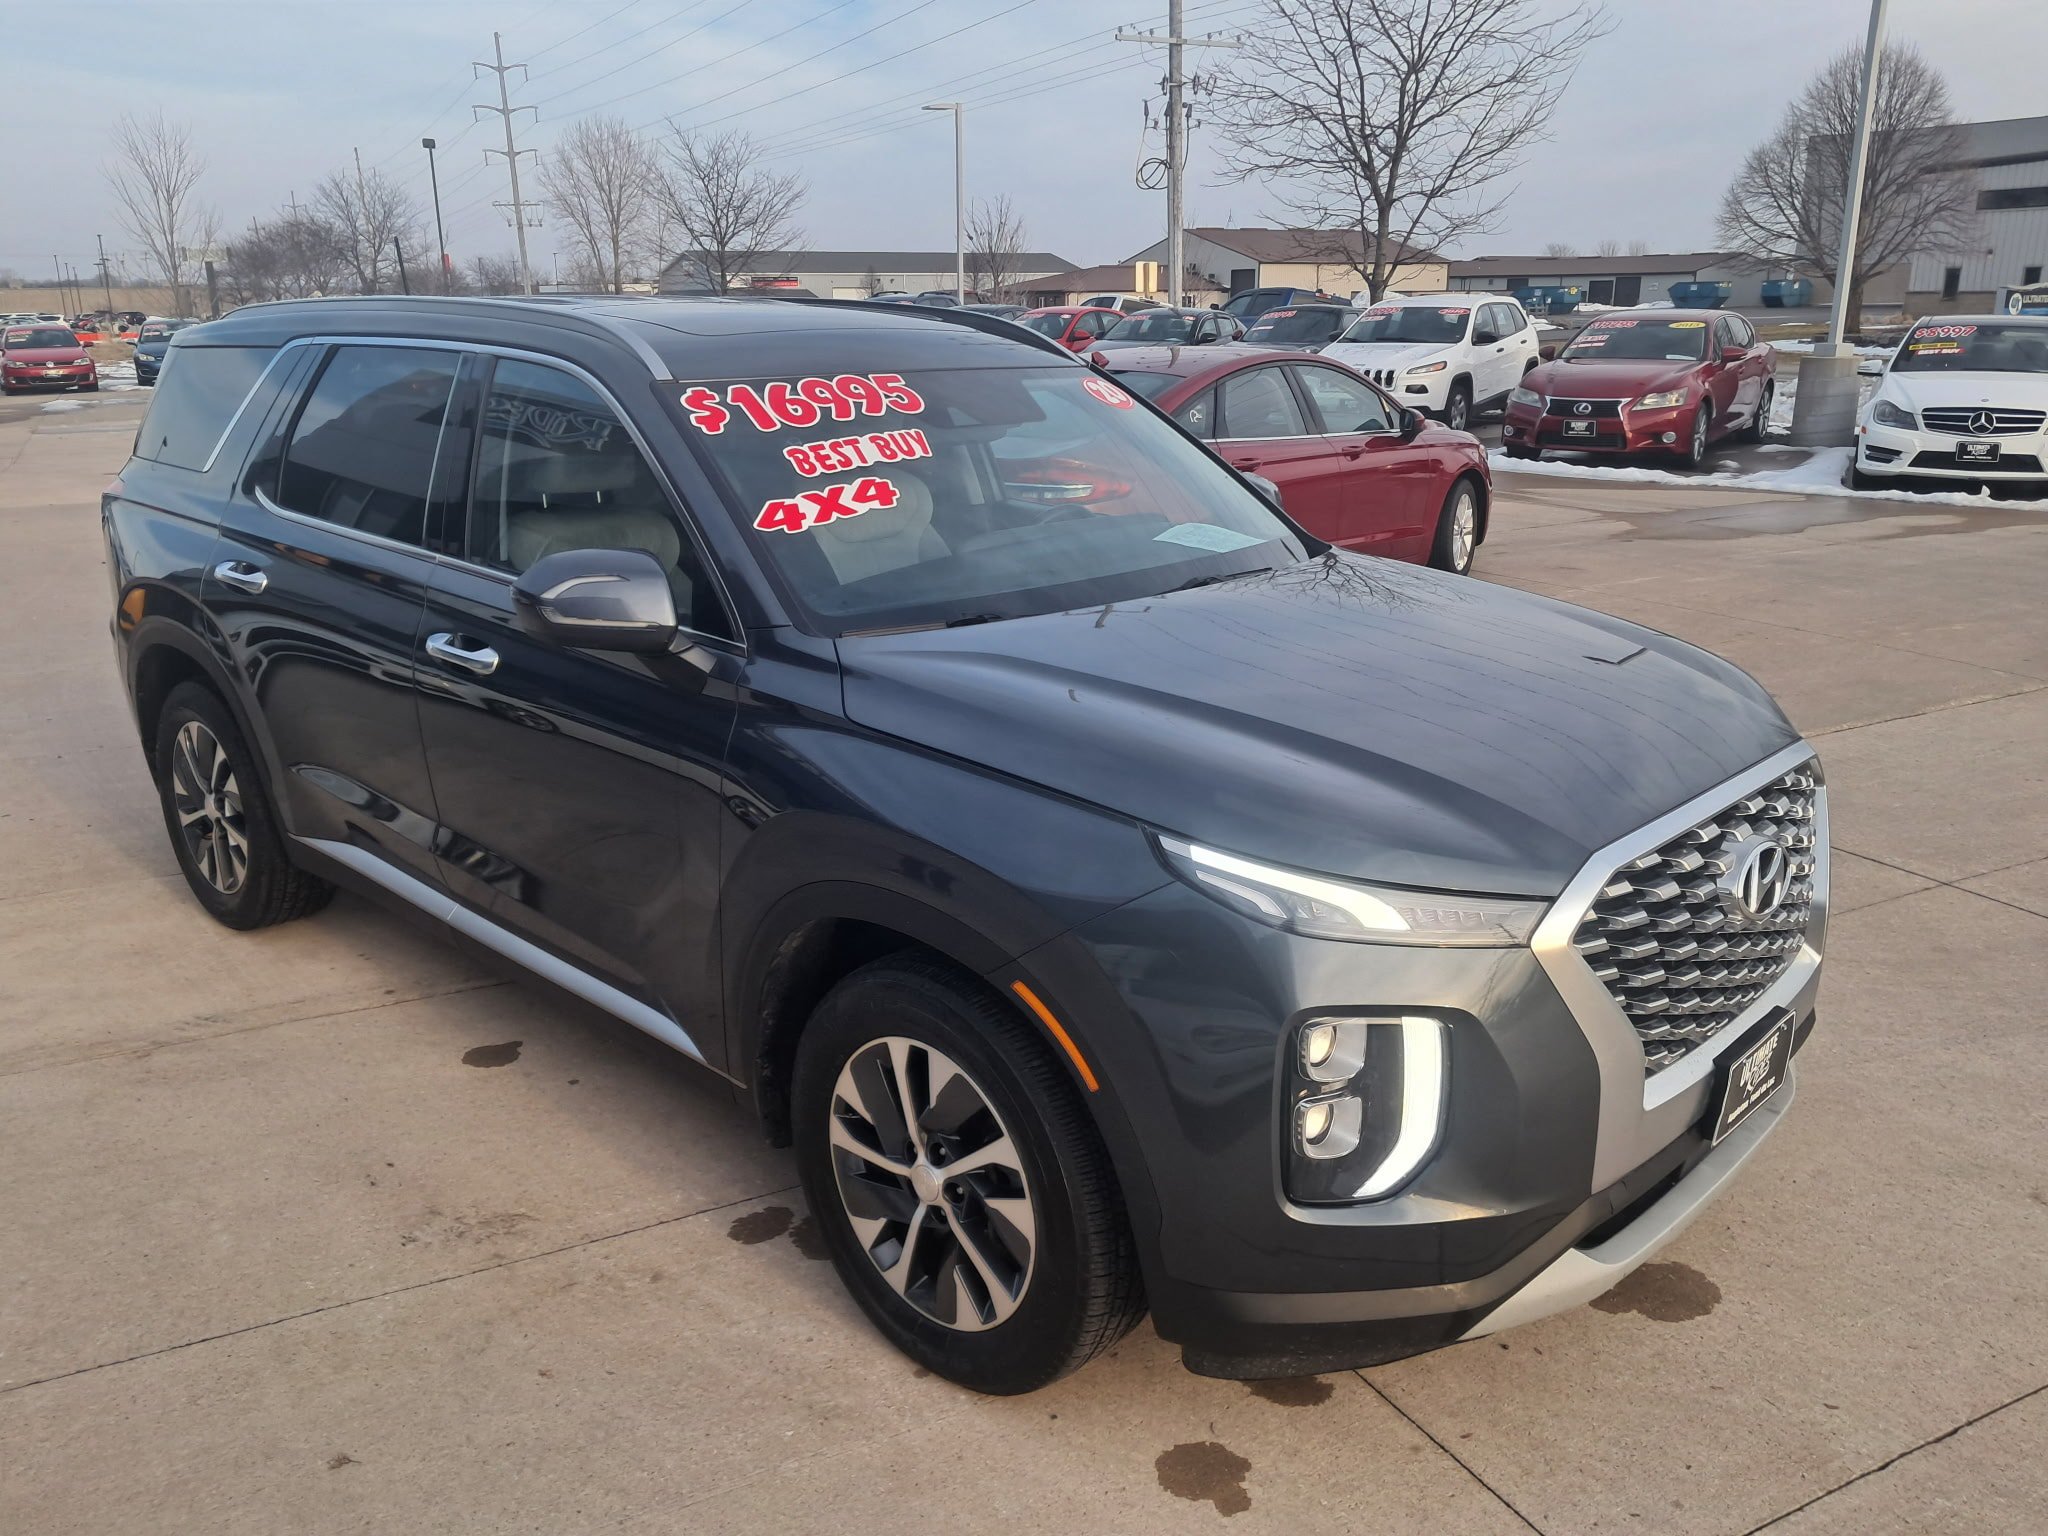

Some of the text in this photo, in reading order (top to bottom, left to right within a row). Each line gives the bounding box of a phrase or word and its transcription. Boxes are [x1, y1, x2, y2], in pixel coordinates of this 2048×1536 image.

[680, 374, 925, 435] $16995
[783, 429, 932, 478] BEST BUY
[754, 477, 900, 533] 4X4
